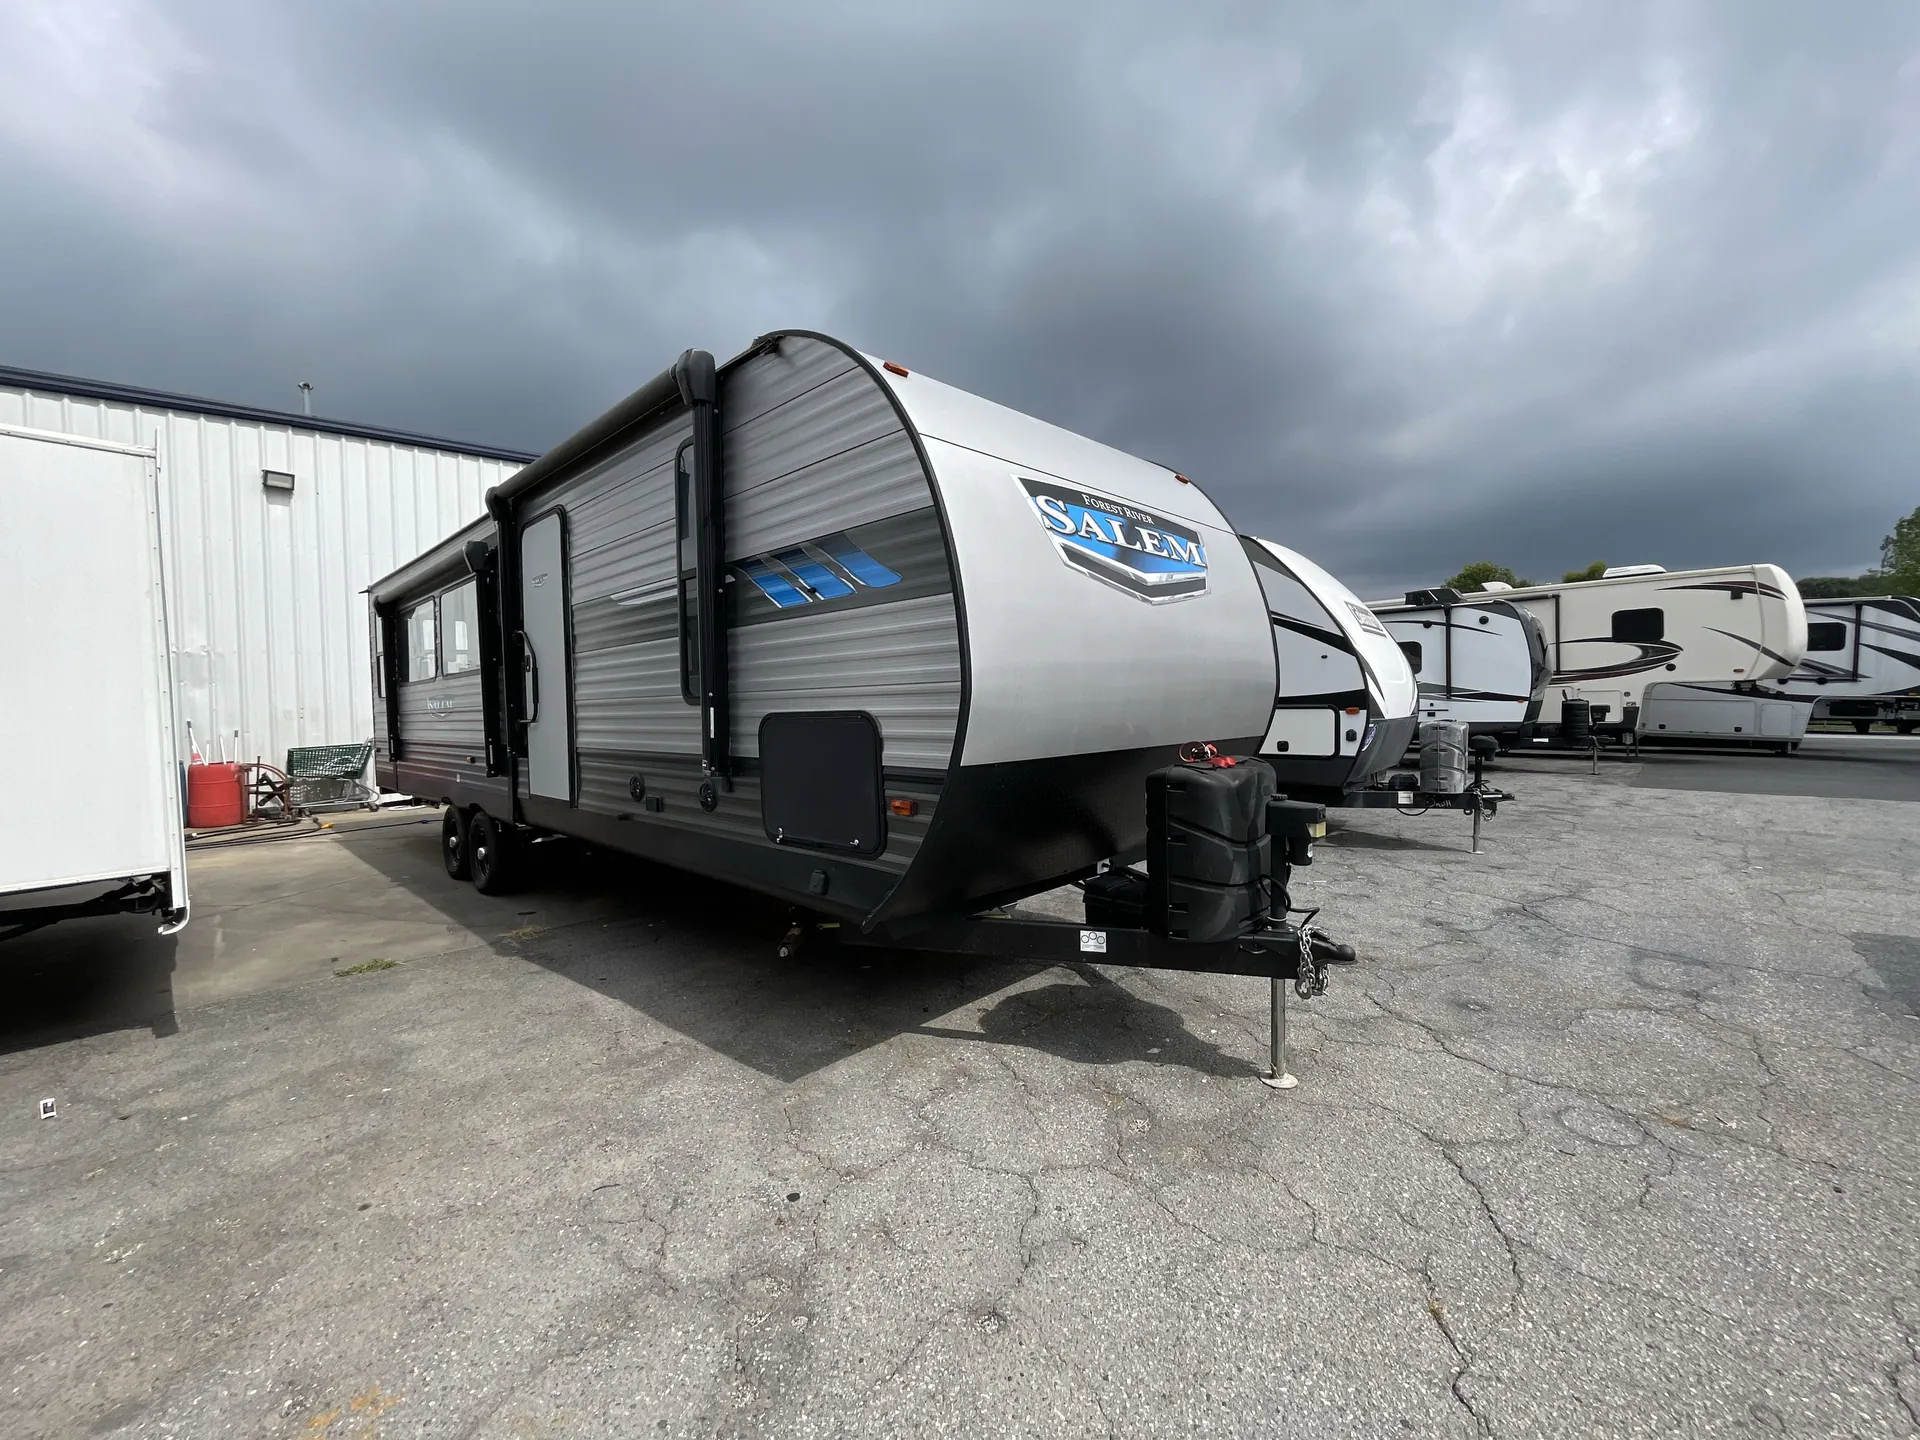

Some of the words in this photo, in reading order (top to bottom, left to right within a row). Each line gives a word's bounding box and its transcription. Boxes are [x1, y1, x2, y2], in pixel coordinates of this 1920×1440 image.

[1035, 494, 1208, 568] SALEM
[1081, 493, 1123, 516] FOREST
[1123, 506, 1155, 525] RIVER
